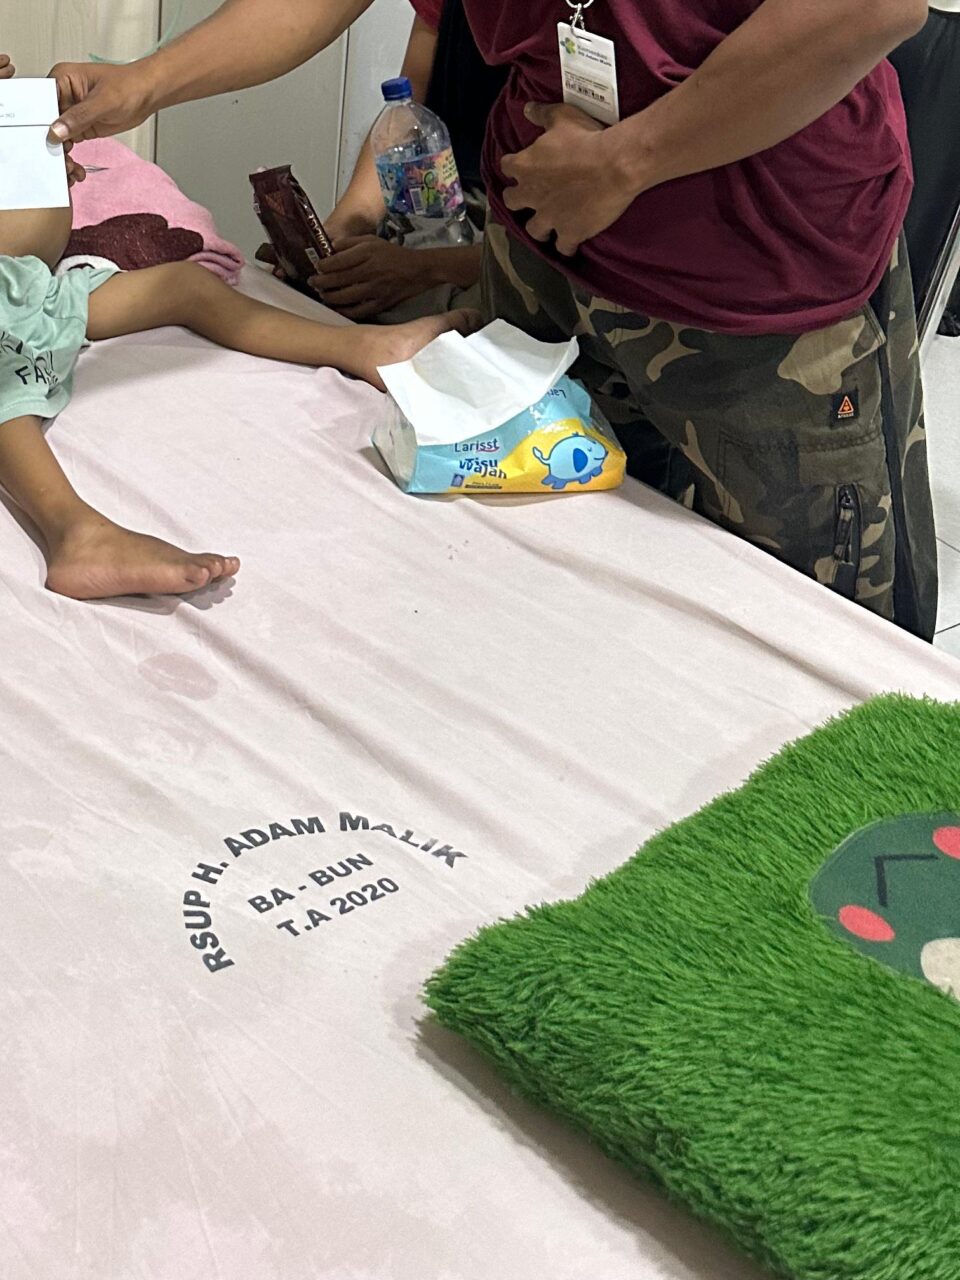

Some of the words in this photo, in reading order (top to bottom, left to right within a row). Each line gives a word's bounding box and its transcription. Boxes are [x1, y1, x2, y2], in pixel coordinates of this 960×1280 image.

[454, 438, 500, 453] Larisst
[223, 816, 326, 858] ADAM
[339, 811, 468, 869] MALIK
[191, 860, 230, 885] H.
[248, 887, 295, 914] BA
[308, 853, 374, 887] BUN
[183, 889, 235, 973] RSUP
[276, 908, 332, 937] T.A
[330, 877, 400, 915] 2020
